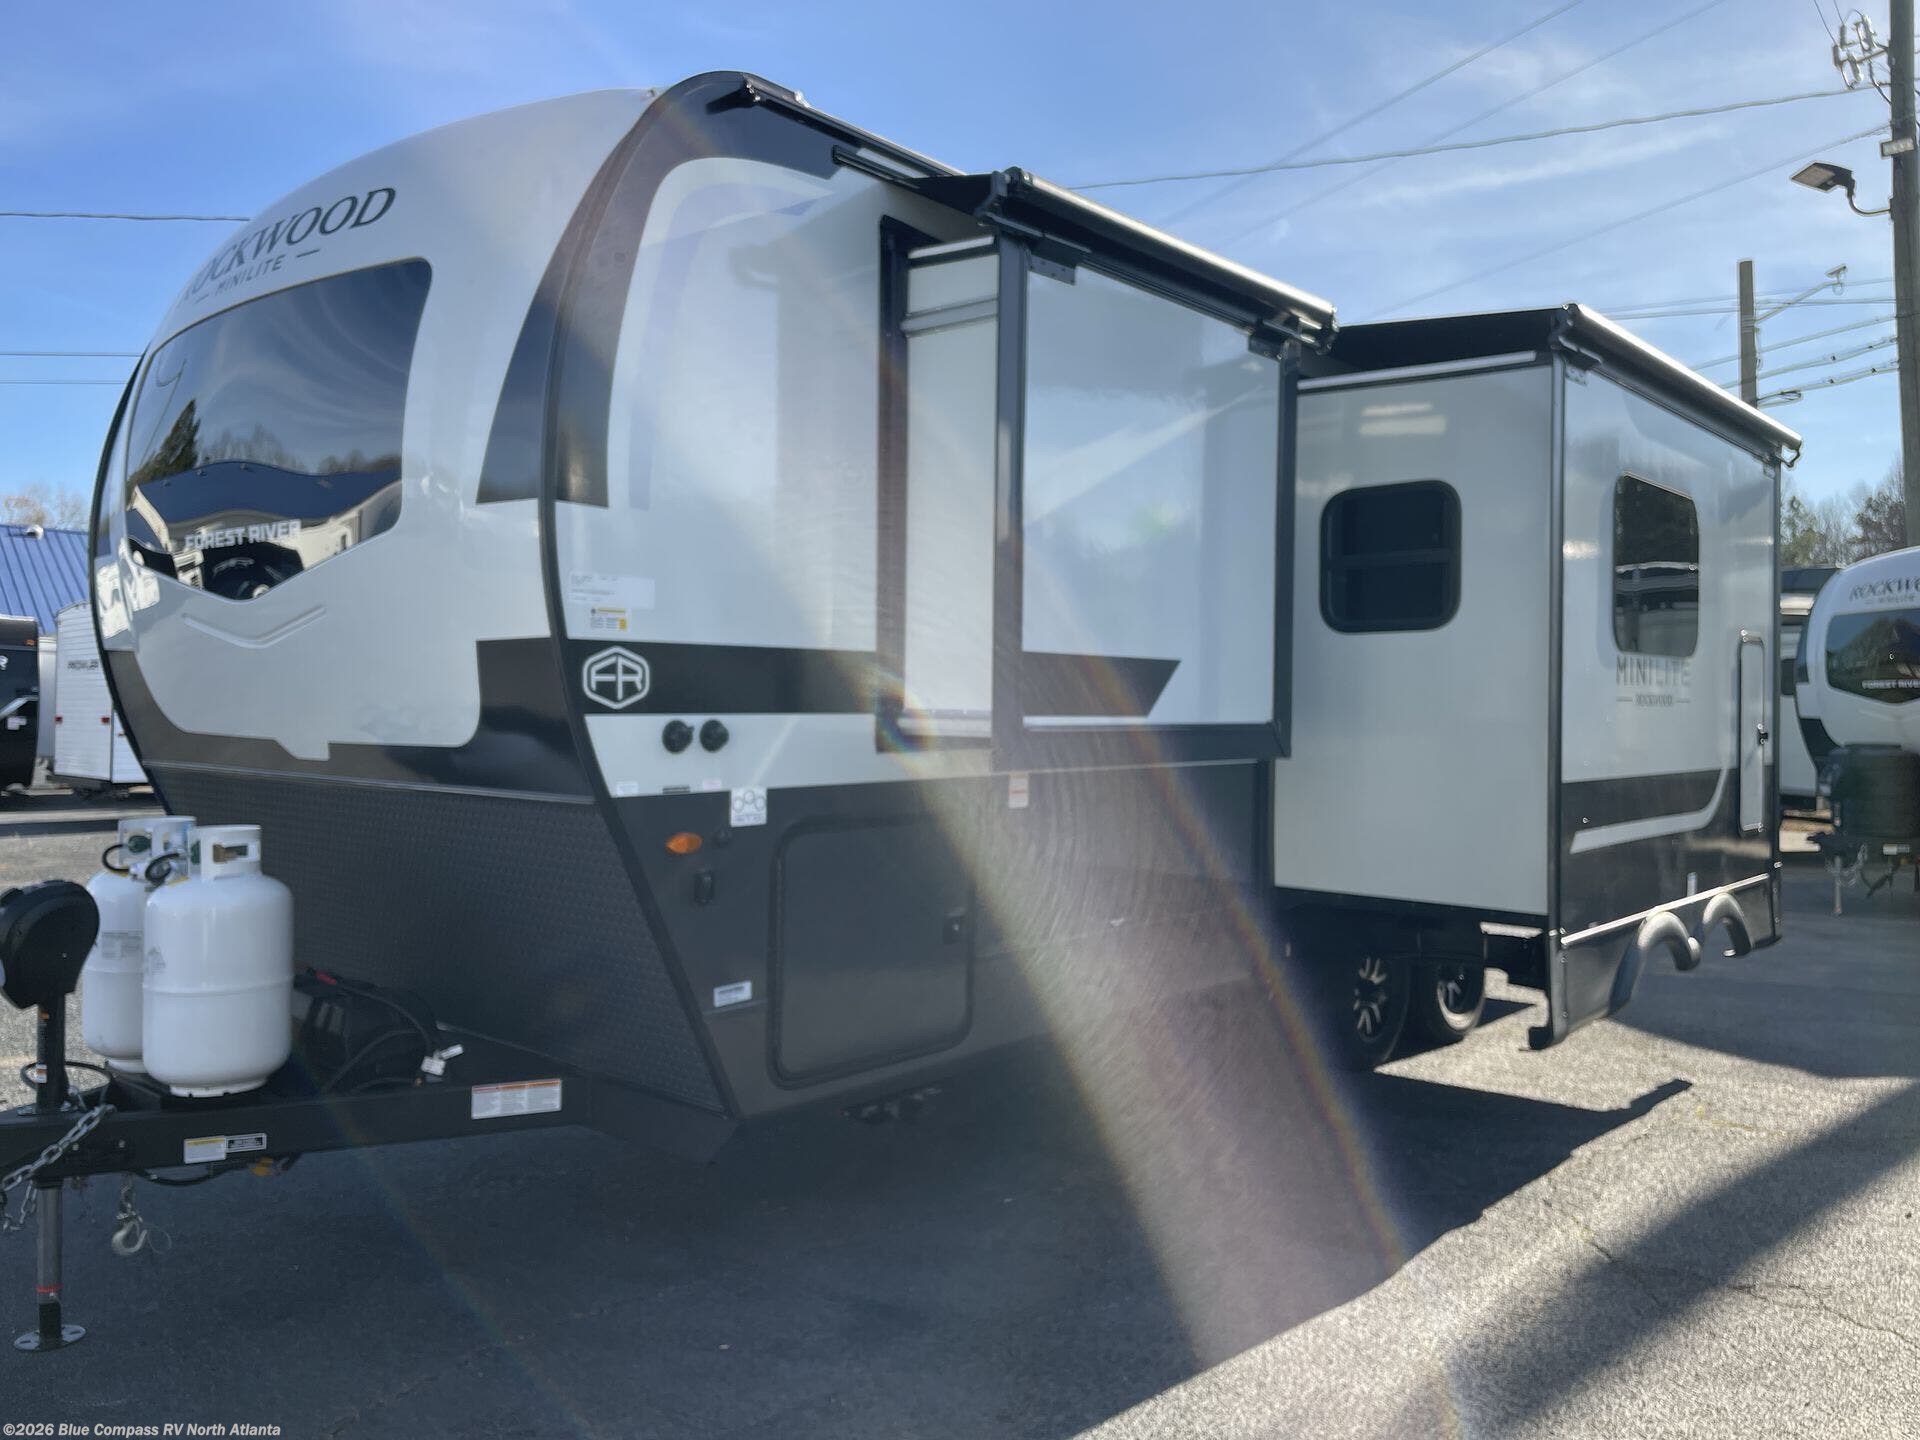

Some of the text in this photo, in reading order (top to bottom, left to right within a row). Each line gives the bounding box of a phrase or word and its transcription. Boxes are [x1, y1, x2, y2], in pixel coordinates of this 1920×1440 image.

[215, 255, 284, 295] MINILITE
[184, 519, 302, 550] FOREST RIVER
